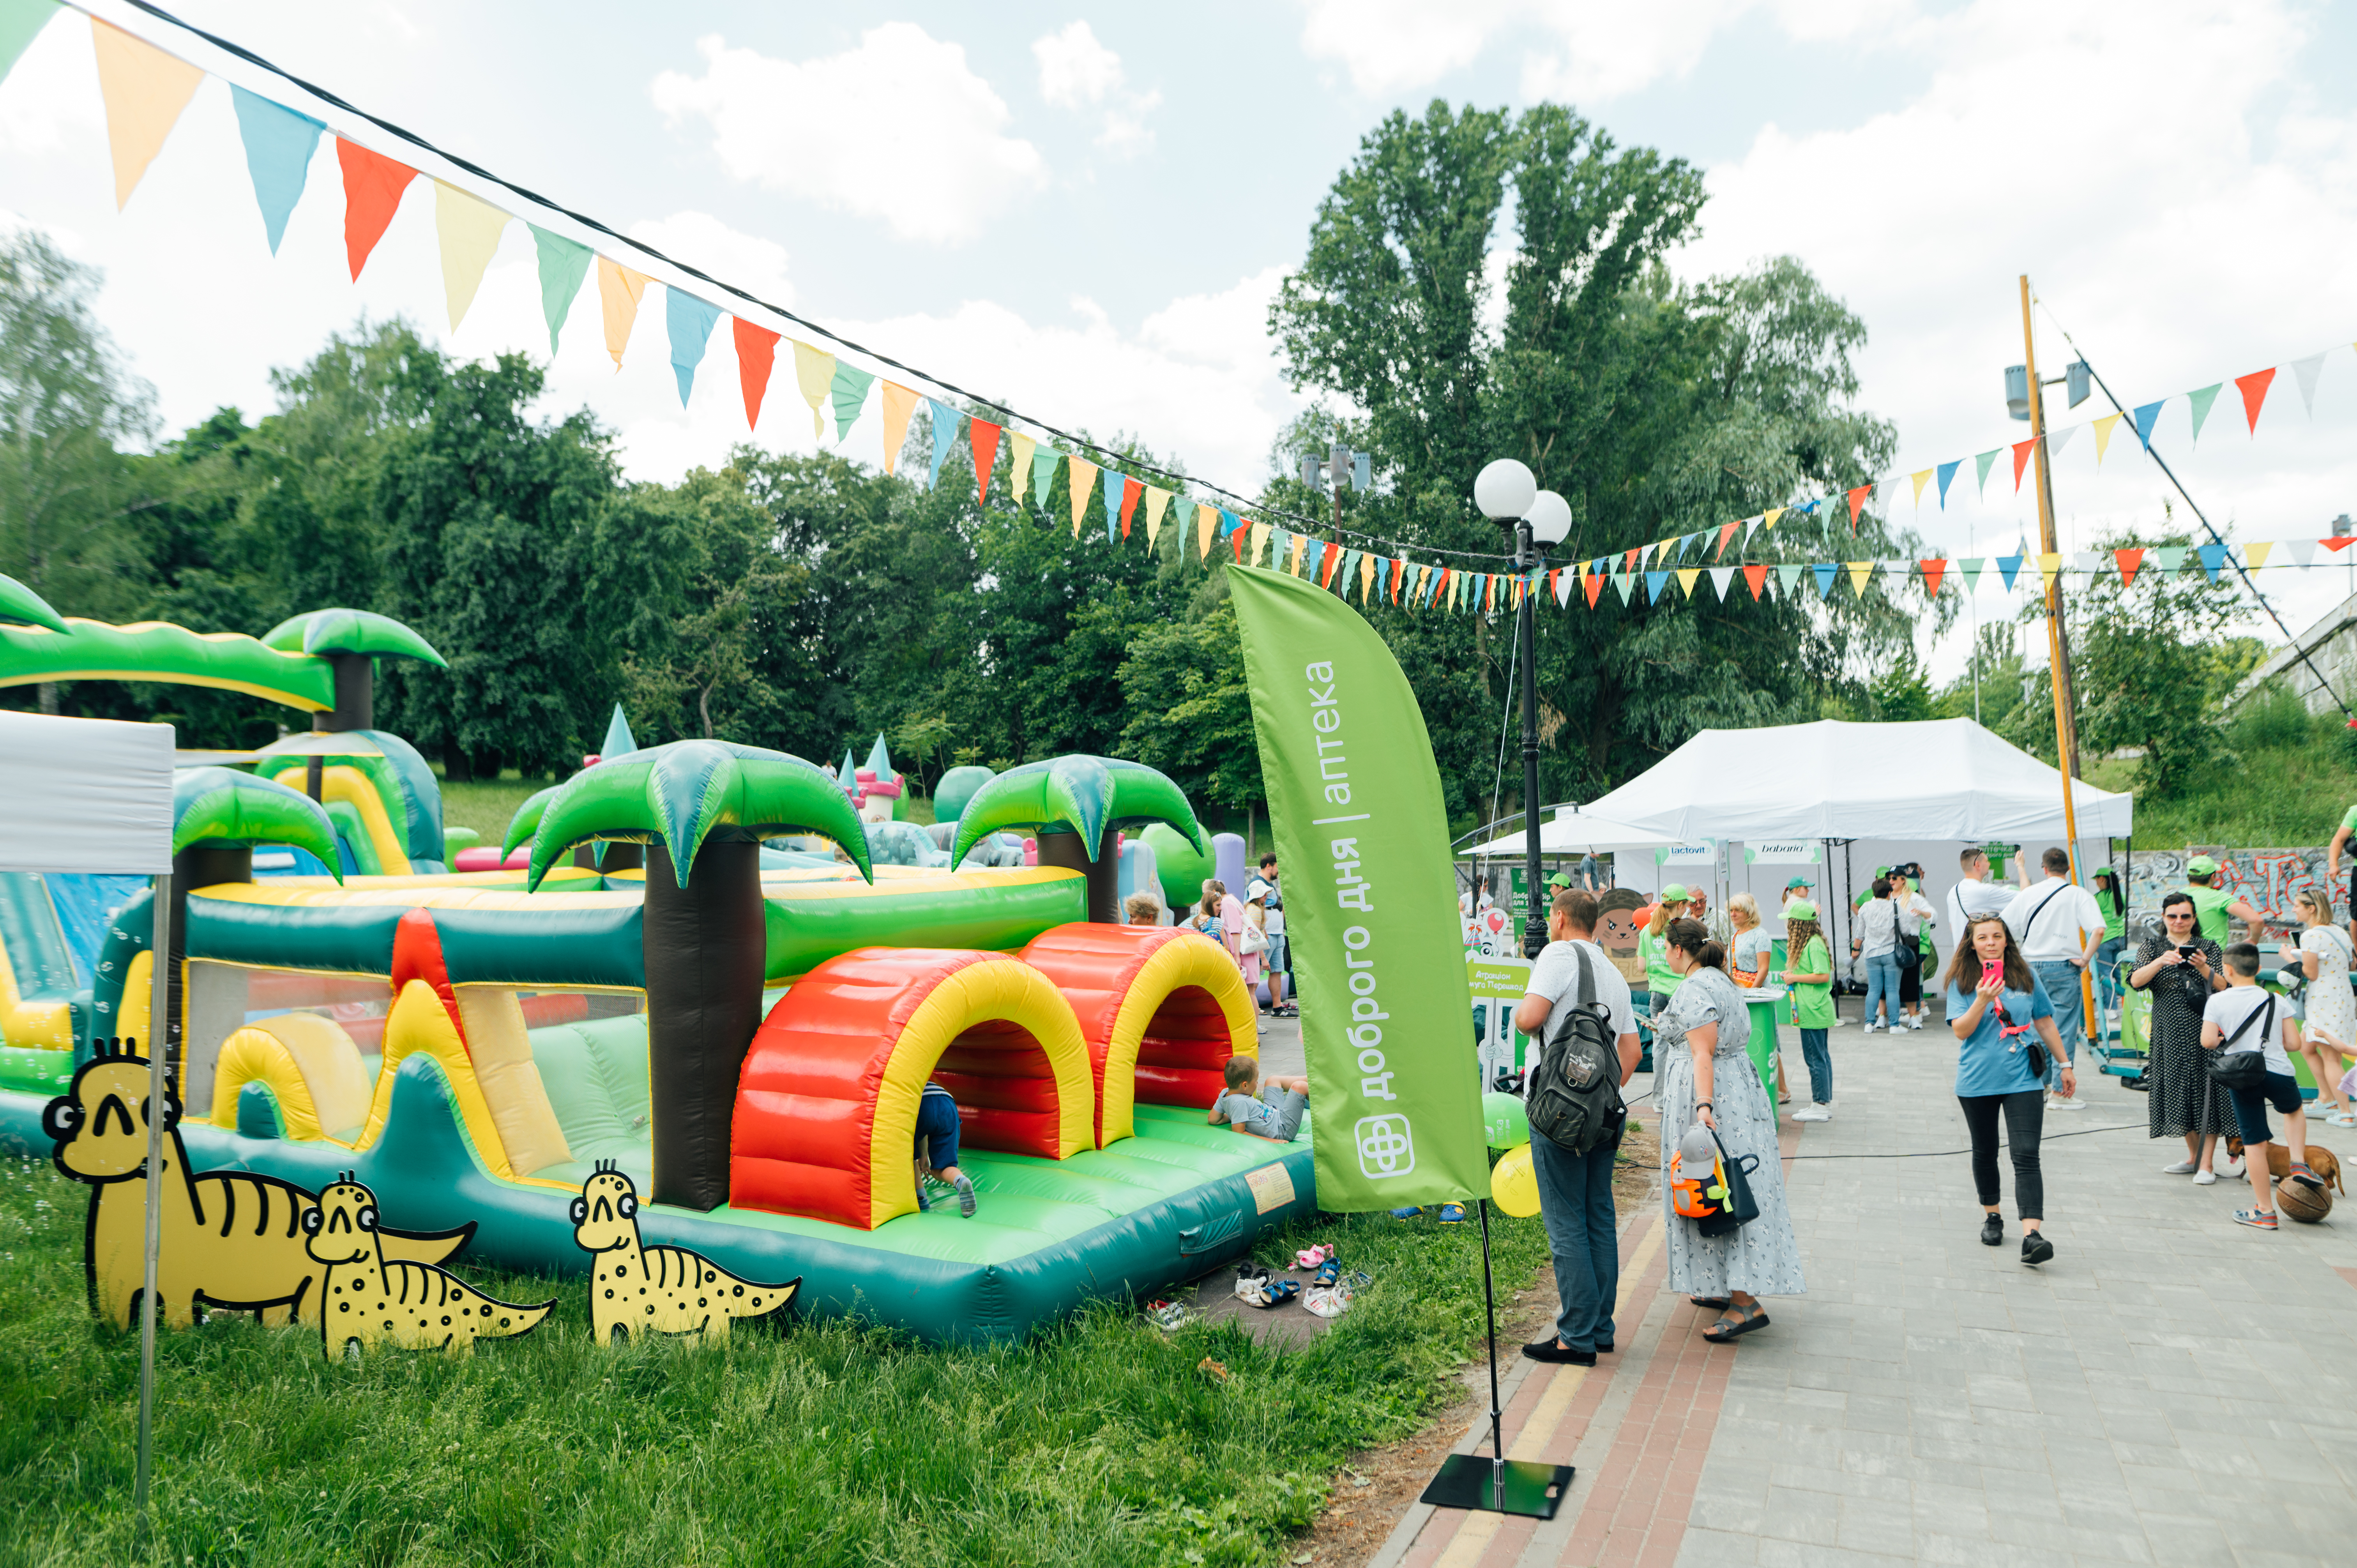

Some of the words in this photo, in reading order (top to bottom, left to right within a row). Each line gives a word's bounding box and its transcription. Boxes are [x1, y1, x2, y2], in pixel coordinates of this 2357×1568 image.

[1306, 661, 1351, 805] аптека
[1762, 843, 1803, 853] babaria
[1331, 837, 1374, 912] дня
[1469, 981, 1486, 989] муга
[1487, 980, 1524, 992] Перешкод
[1475, 970, 1511, 981] Атракціон
[1343, 925, 1397, 1101] доброго
